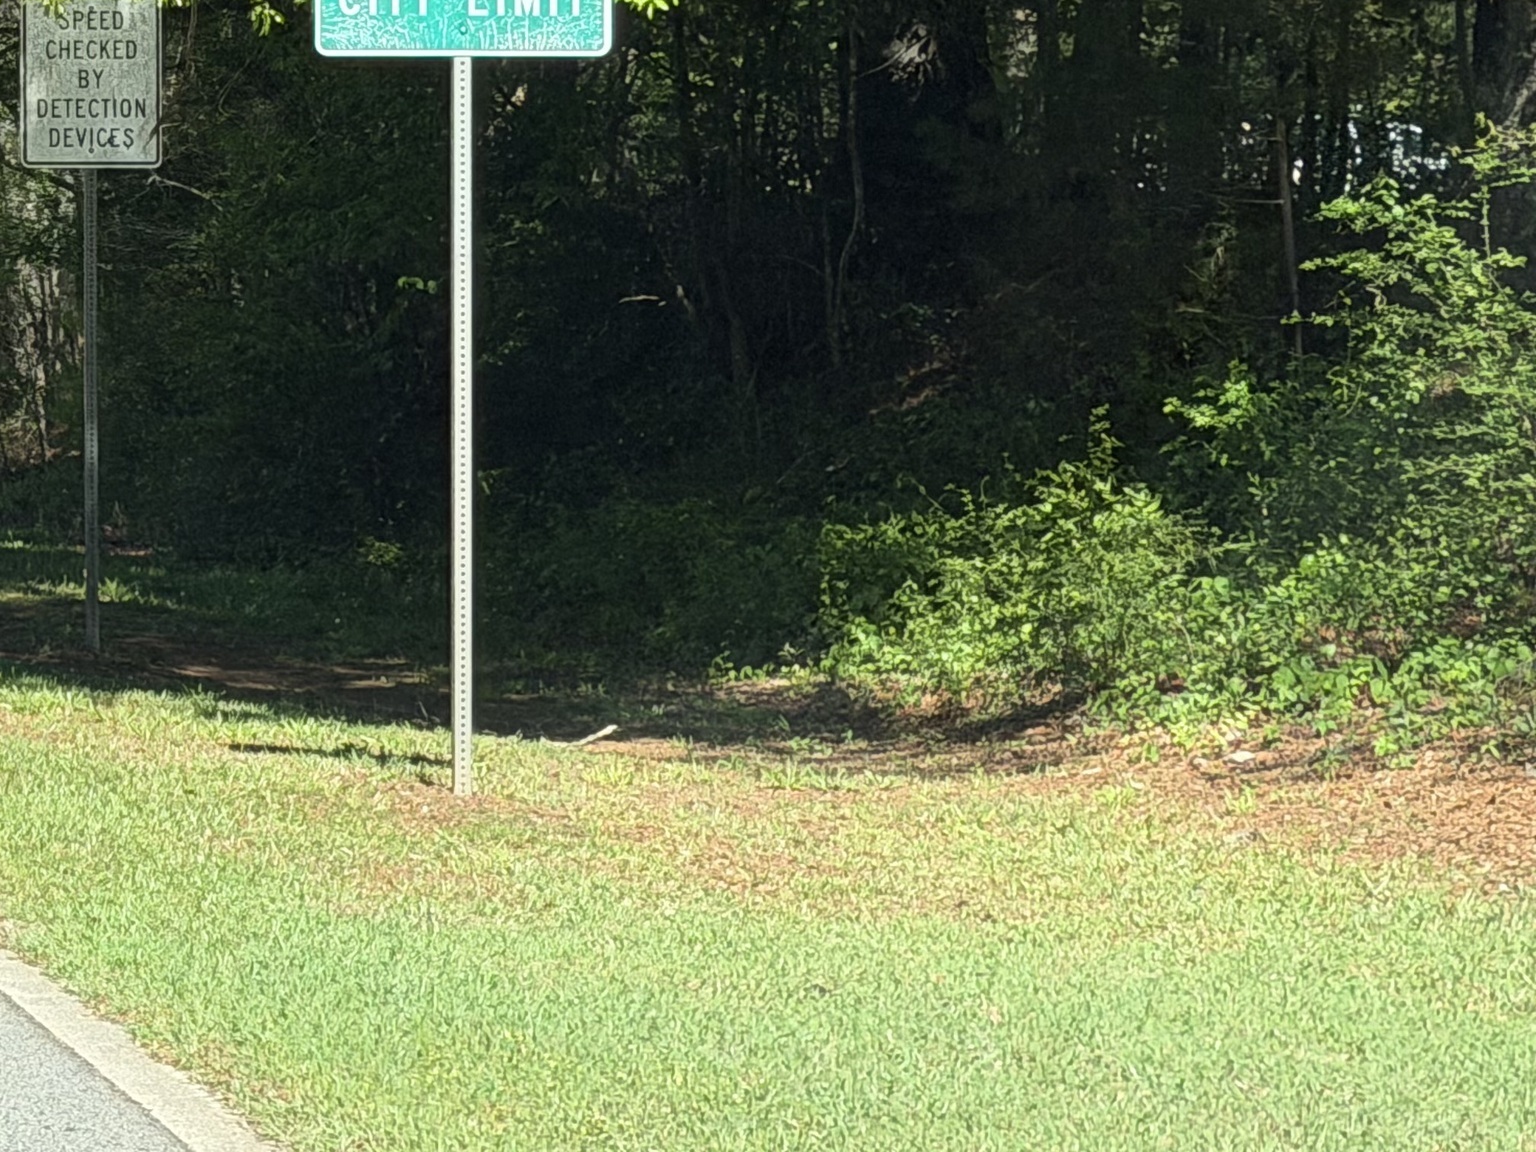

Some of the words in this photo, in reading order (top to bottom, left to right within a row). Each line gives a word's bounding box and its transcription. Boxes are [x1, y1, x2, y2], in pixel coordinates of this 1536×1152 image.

[58, 10, 124, 31] SPEED
[45, 39, 138, 60] CHECKED
[77, 68, 104, 89] BY
[36, 98, 147, 119] DETECTION
[48, 127, 135, 148] DEVICES
